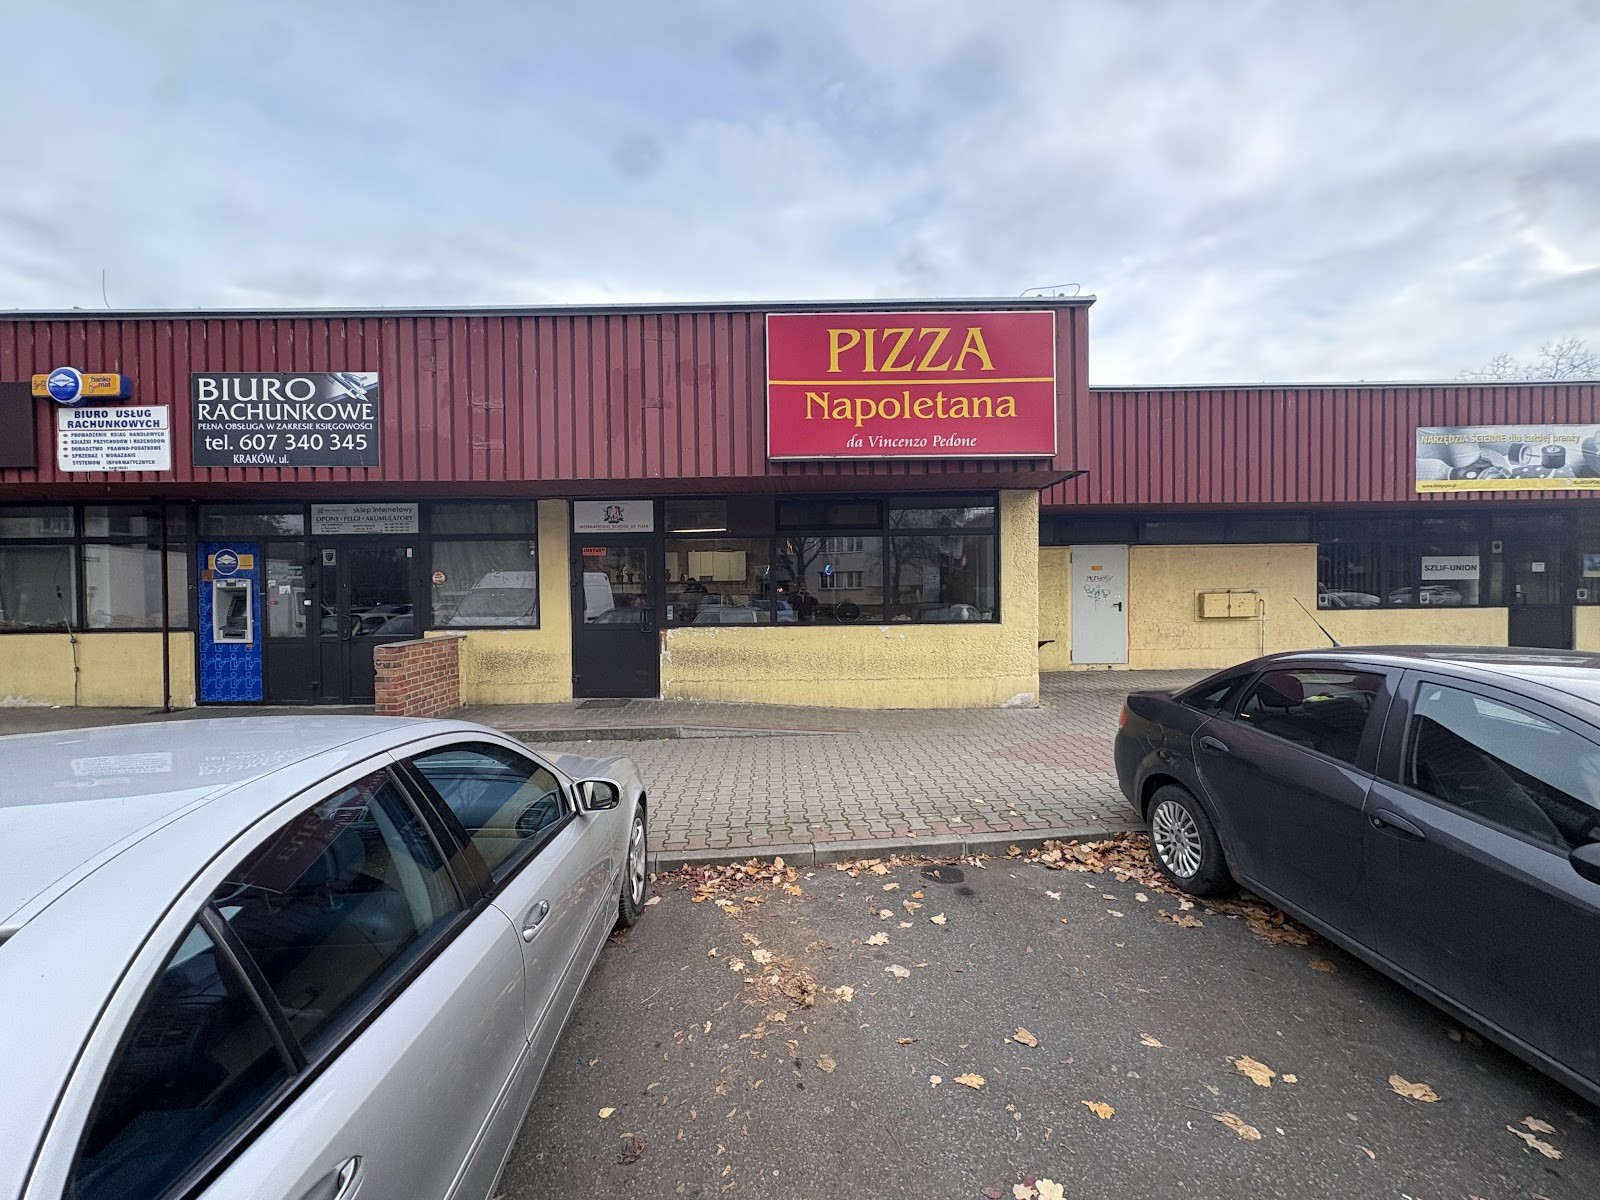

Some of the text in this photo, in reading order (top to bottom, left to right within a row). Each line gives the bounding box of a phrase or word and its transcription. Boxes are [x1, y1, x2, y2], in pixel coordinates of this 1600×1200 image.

[826, 326, 996, 373] PIZZA
[198, 377, 316, 401] BIURO
[74, 409, 152, 419] BIURO USŁUG
[198, 403, 374, 421] RACHUNKOWE
[804, 391, 1017, 427] Napoletana
[67, 420, 160, 429] RACHUNKOWYCH
[198, 421, 373, 431] PEŁNA OBSŁUGA W ZAKRESIE KSIĘGOWOŚCI
[205, 434, 368, 451] tel. 607 340 345
[846, 432, 977, 449] da Vincenzo Pedone
[1420, 434, 1469, 446] NARZĘDZIA
[1508, 433, 1521, 442] dla
[233, 452, 289, 464] KRAKÓW, ul.
[372, 506, 413, 514] internetowy
[1424, 564, 1477, 572] SZLIF-UNION
